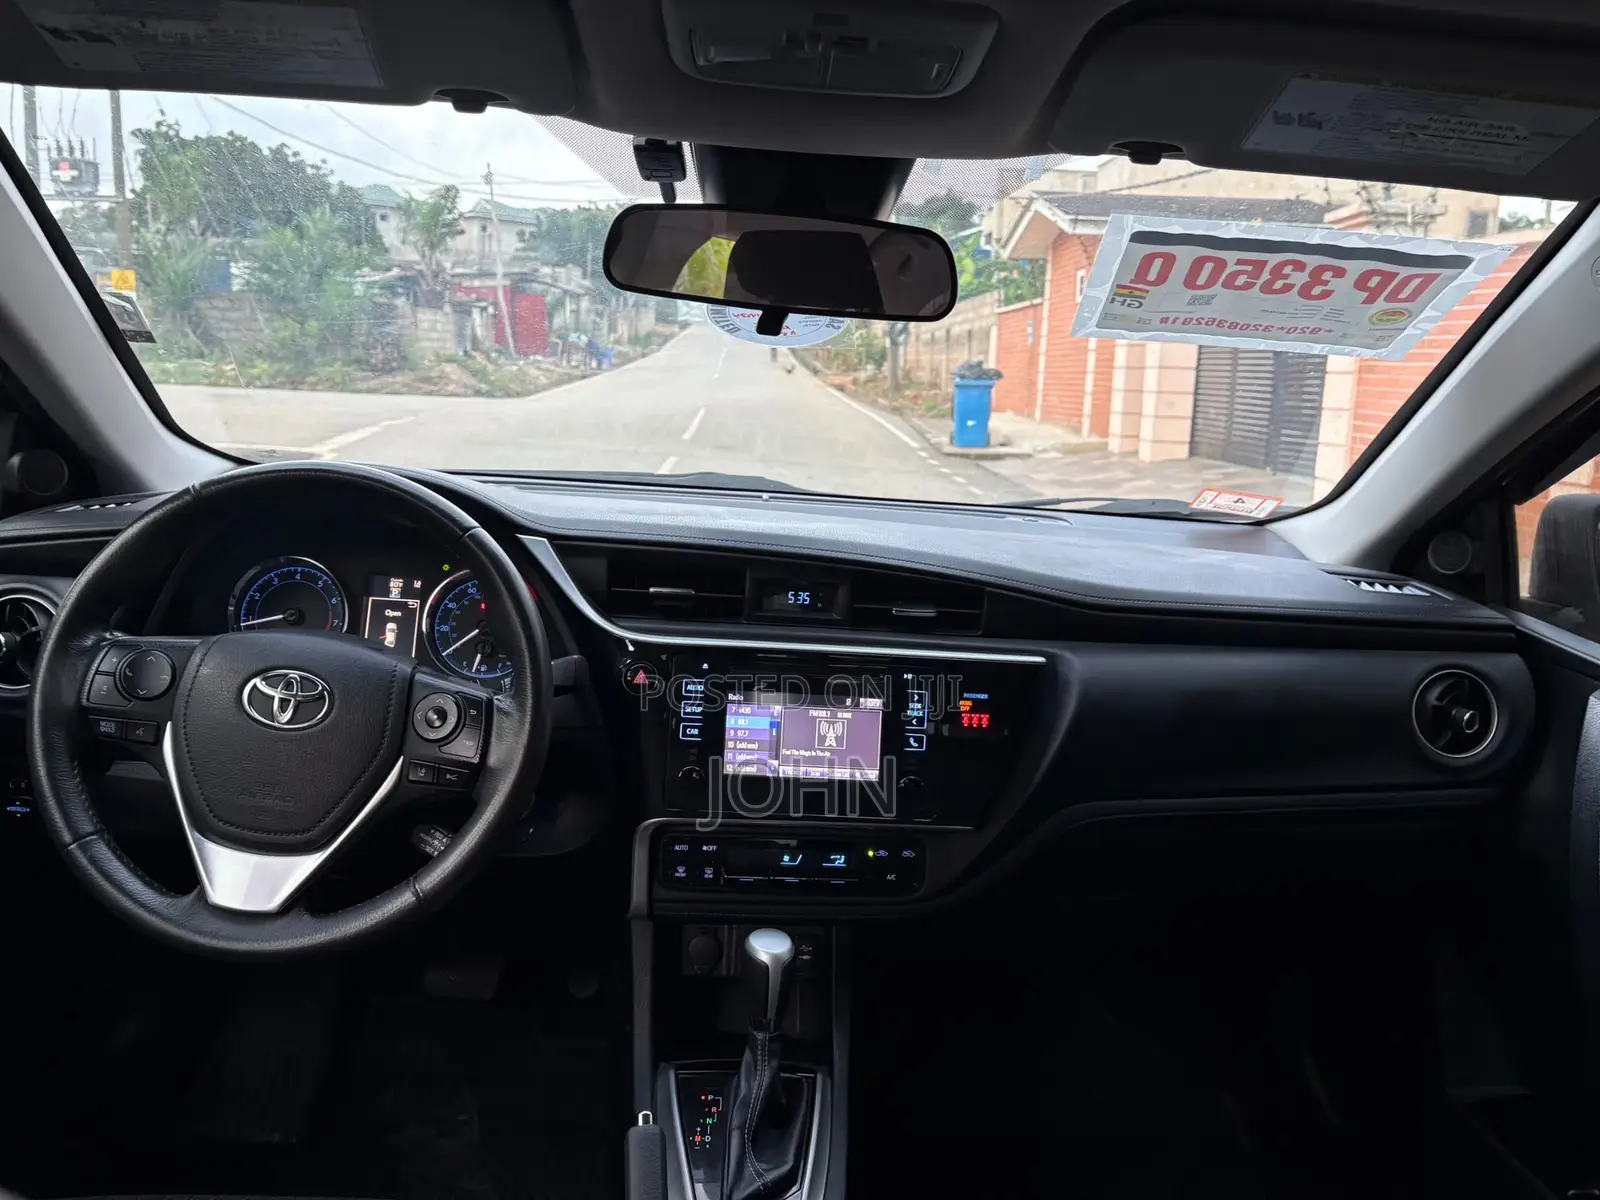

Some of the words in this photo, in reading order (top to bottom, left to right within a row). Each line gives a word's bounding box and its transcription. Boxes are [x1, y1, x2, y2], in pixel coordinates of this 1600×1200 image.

[318, 580, 324, 588] 5
[254, 592, 260, 600] 2
[385, 609, 402, 617] Open
[728, 693, 744, 701] Radio
[886, 873, 897, 881] A/C
